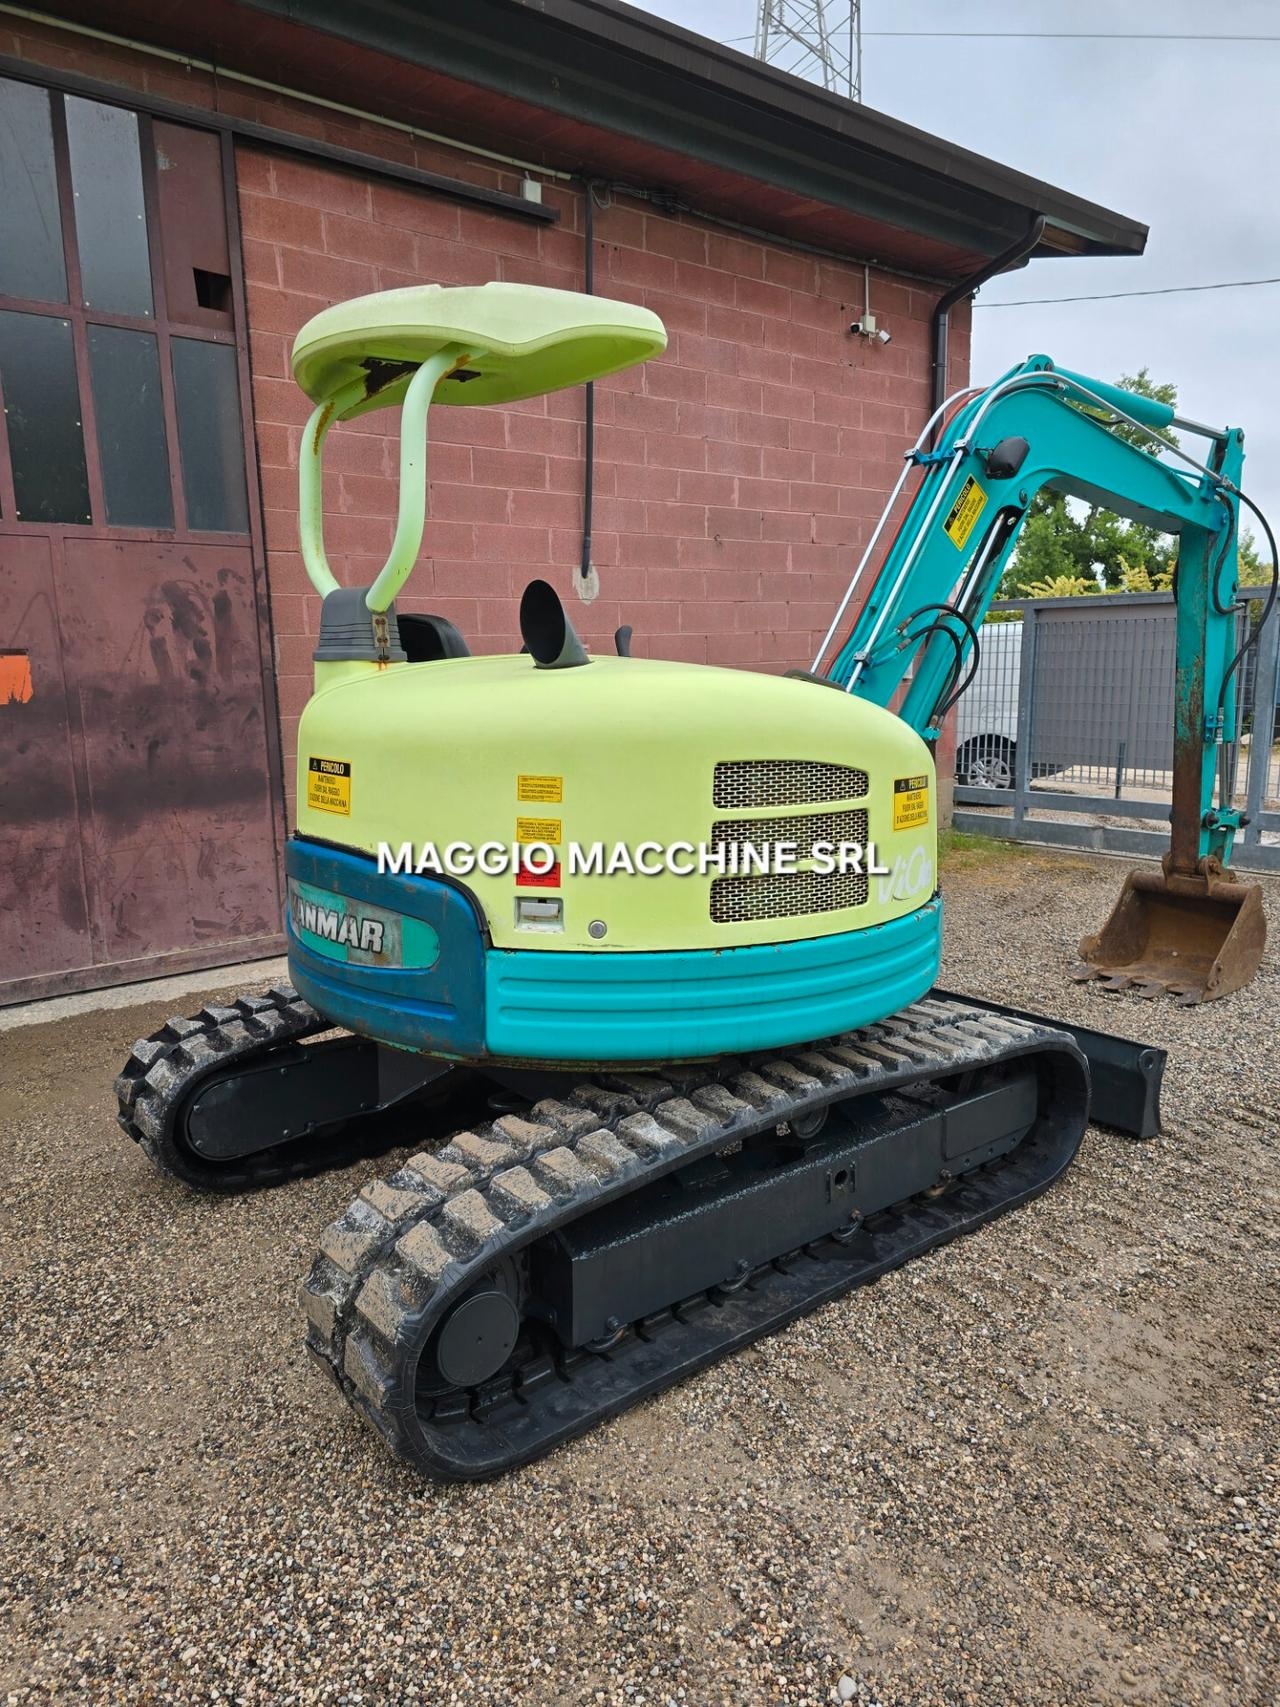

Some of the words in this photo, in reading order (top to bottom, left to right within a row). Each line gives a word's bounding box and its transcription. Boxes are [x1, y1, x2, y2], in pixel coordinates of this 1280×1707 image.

[953, 483, 971, 513] PERICOLO
[320, 760, 345, 774] PERICOLO
[291, 893, 385, 954] ANMAR
